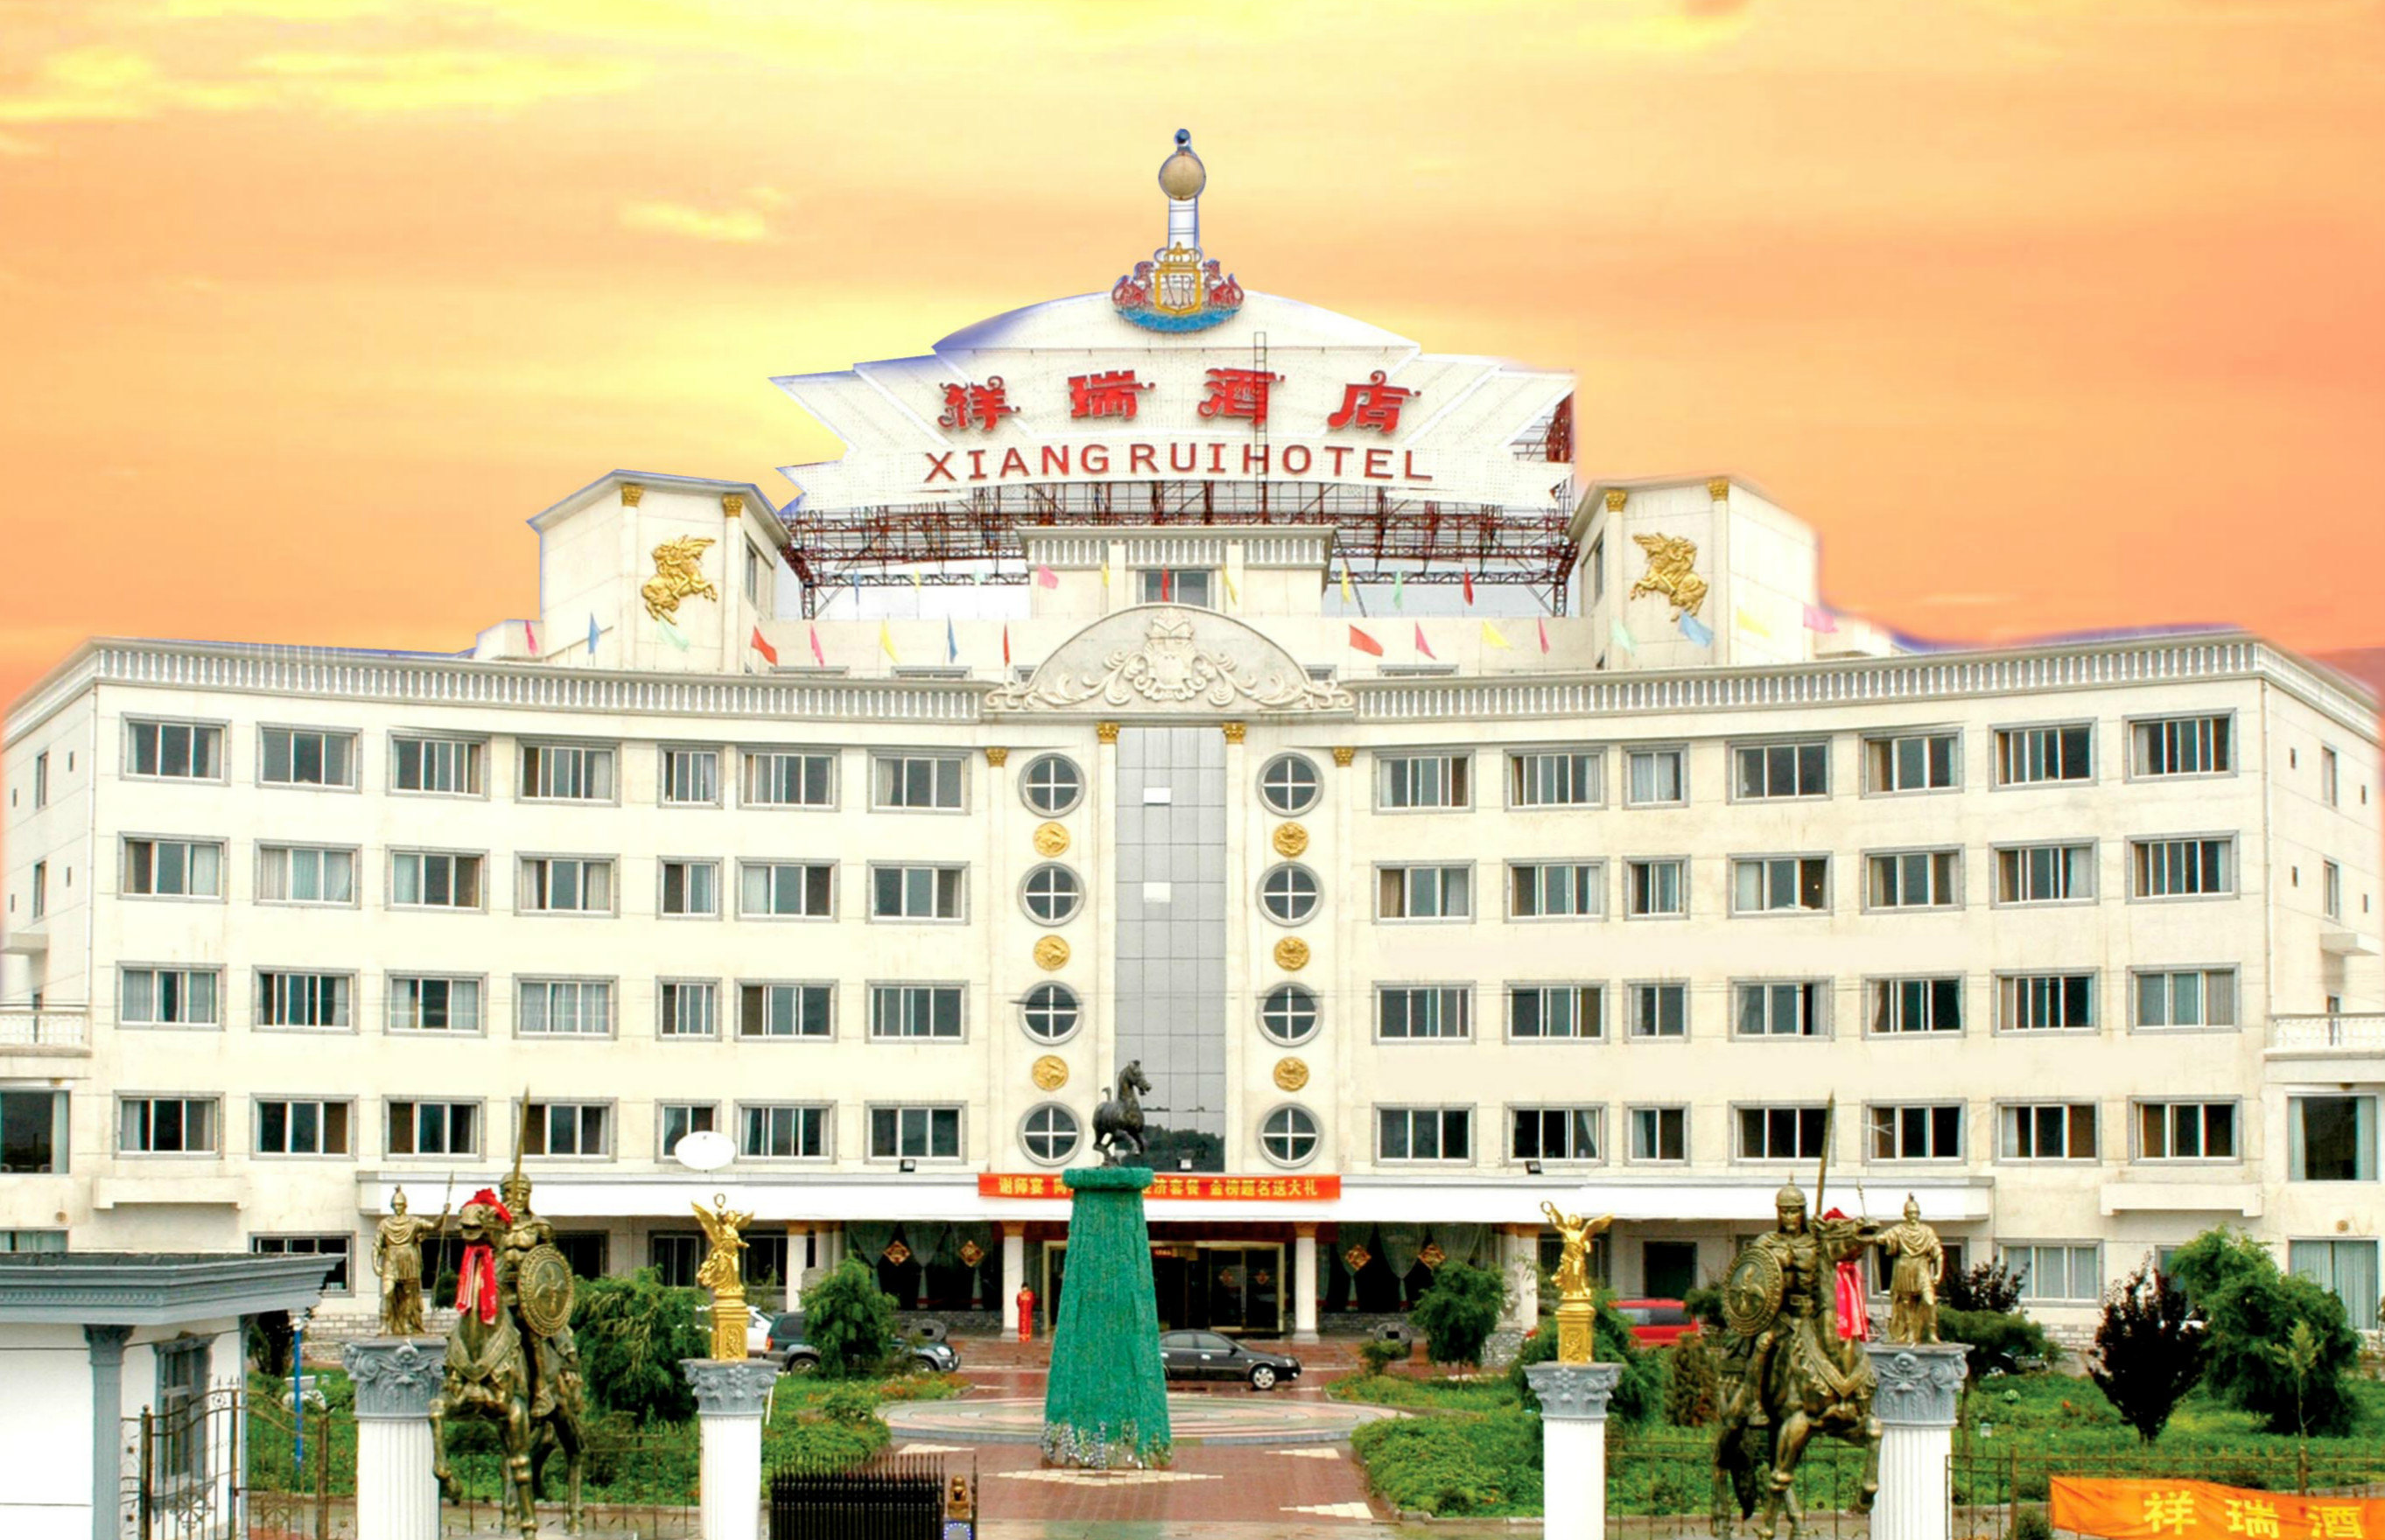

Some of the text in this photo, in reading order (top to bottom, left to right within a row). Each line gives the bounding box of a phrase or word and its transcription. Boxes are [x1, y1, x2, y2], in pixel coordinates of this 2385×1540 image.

[937, 370, 1421, 434] 祥瑞酒店
[2143, 1490, 2363, 1538] 祥瑞酒
